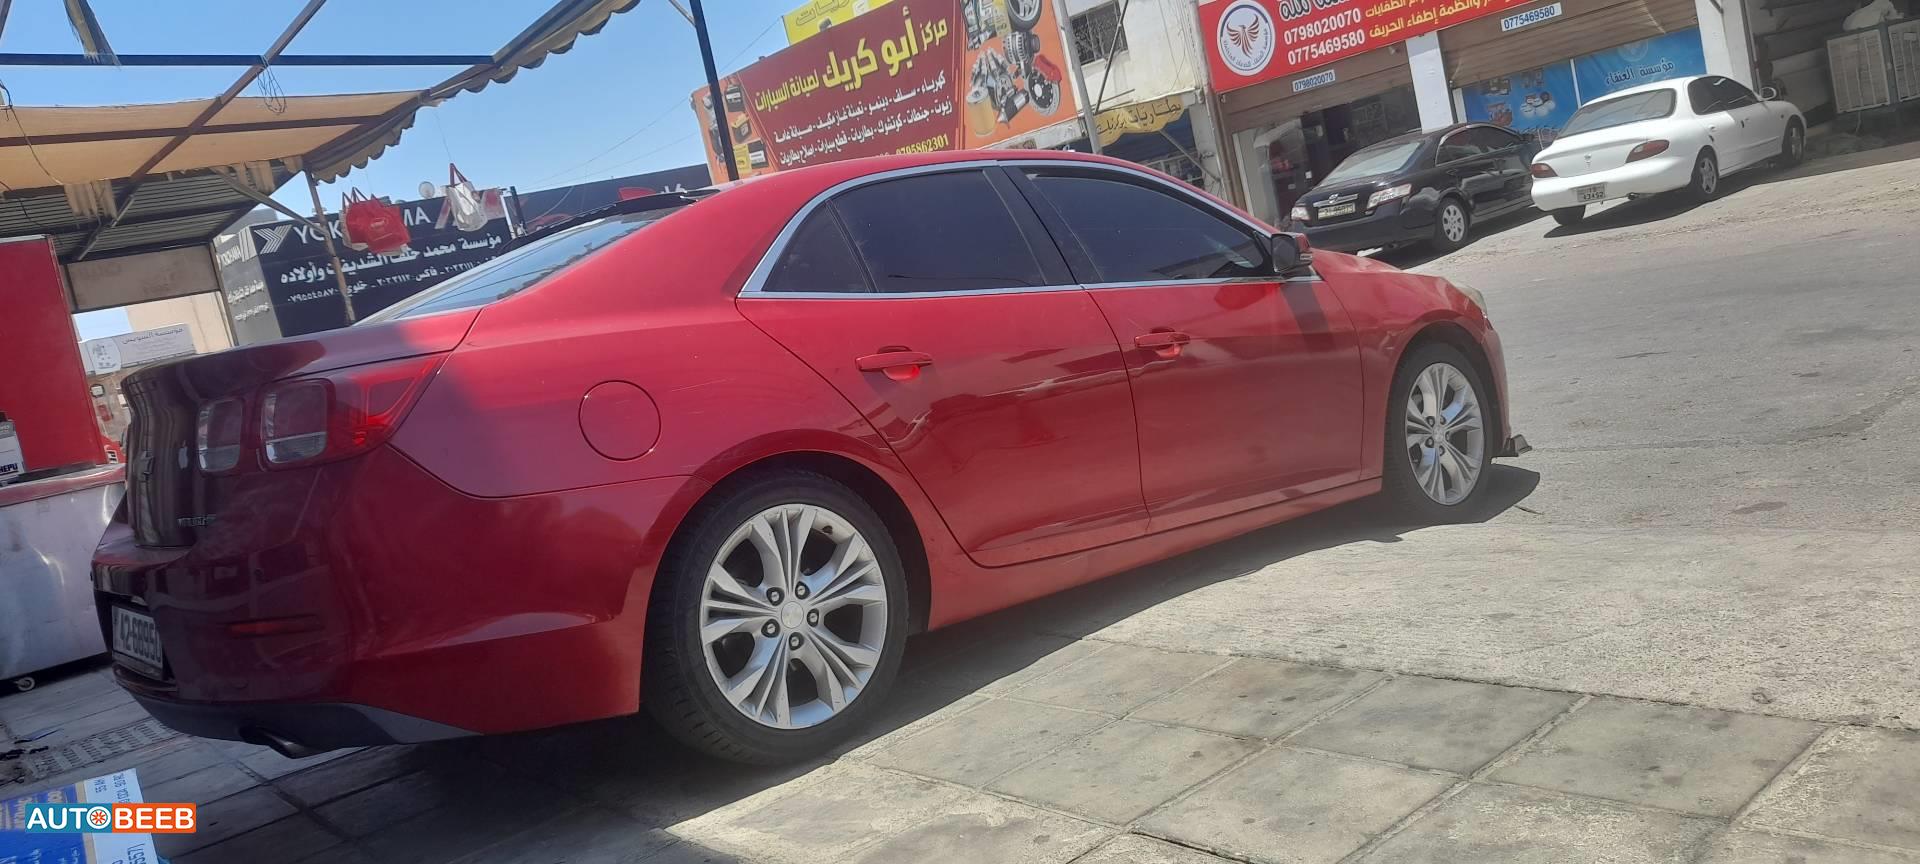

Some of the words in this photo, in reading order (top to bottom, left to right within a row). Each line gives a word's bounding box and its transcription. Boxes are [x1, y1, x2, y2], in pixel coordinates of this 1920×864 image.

[1283, 8, 1361, 45] 0798020070
[1503, 6, 1555, 29] 0775469580
[881, 5, 919, 77] أبو
[920, 18, 948, 51] مركز
[1287, 29, 1366, 65] 0775469580
[822, 37, 879, 92] كريك
[1606, 67, 1635, 84] العنقاء
[1639, 59, 1674, 77] مؤسسة
[790, 69, 820, 97] لصيانة
[1294, 72, 1334, 91] 0798020070
[755, 81, 790, 112] السيارات
[933, 95, 953, 116] زيوت
[835, 130, 849, 152] قطع
[850, 126, 874, 143] بطاريات
[423, 243, 457, 257] محمد
[458, 232, 502, 249] مؤسسة
[281, 262, 326, 284] وأولاده
[326, 253, 389, 276] الشديفت
[416, 266, 438, 282] فاكس
